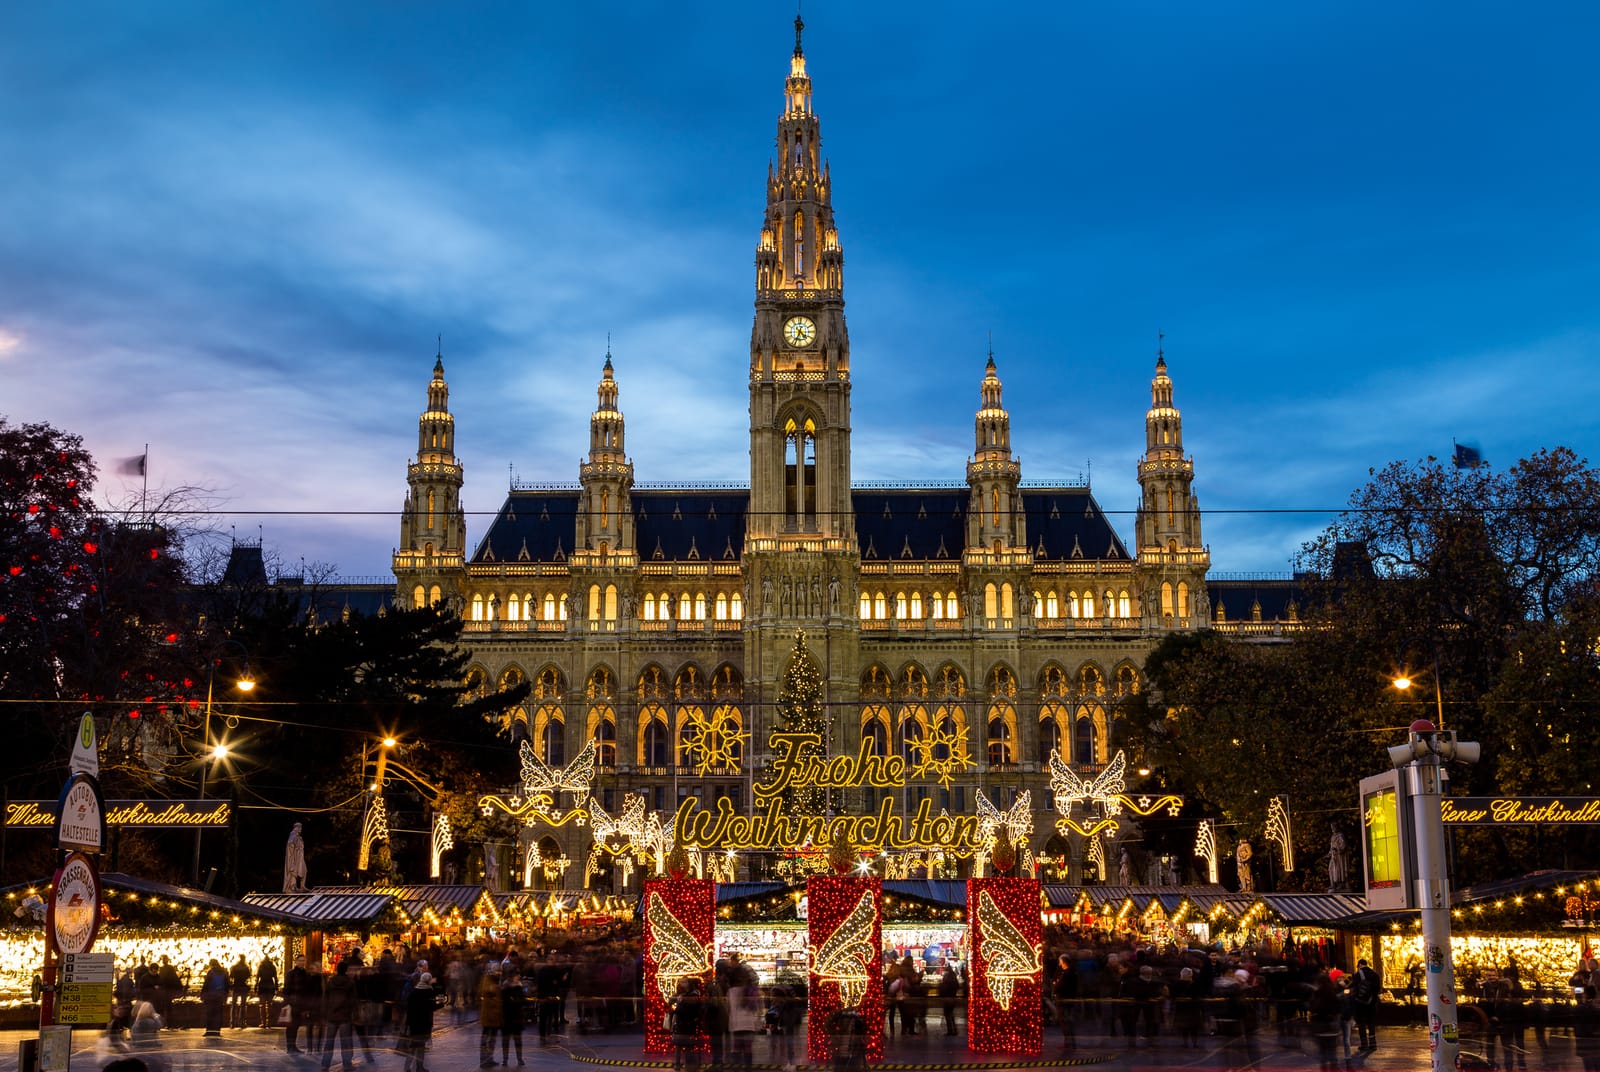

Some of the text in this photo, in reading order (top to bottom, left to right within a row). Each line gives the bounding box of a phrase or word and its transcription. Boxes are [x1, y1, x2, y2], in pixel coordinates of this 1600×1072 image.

[753, 733, 906, 797] Frohe
[70, 786, 96, 813] AUTOBUS
[1490, 799, 1600, 822] Christkindlm
[6, 802, 232, 825] Wiene istkindlmarkt
[673, 796, 987, 849] Weihnachten
[62, 824, 99, 843] HALTESTELLE
[57, 865, 95, 902] STRASSENBAHN
[56, 923, 91, 949] HALTESTELLE
[63, 984, 80, 992] N25
[61, 1004, 79, 1012] N60
[61, 1014, 78, 1022] N66
